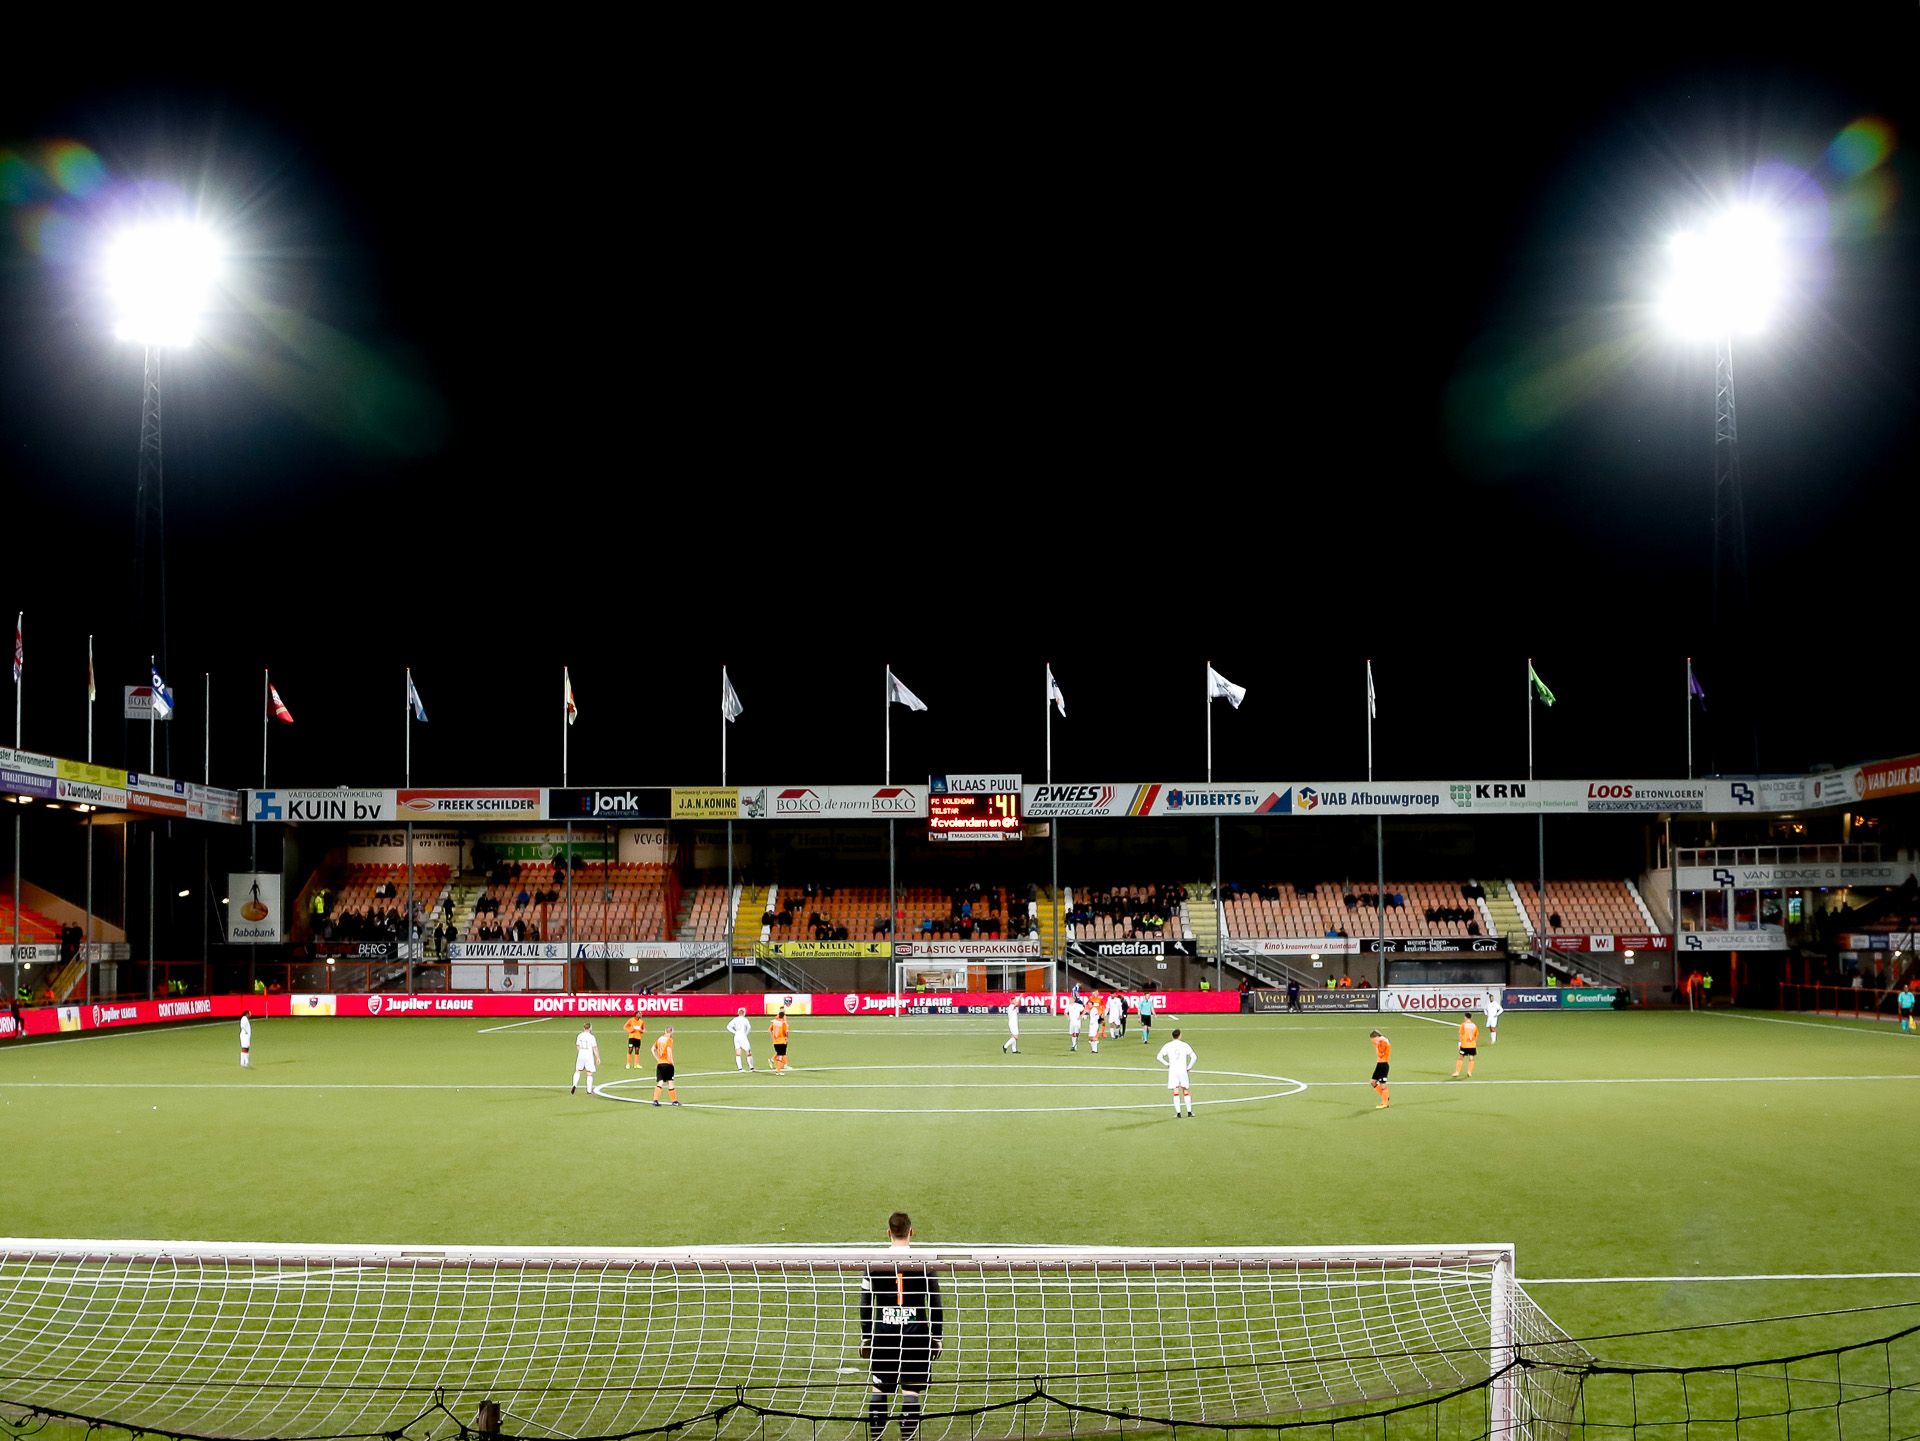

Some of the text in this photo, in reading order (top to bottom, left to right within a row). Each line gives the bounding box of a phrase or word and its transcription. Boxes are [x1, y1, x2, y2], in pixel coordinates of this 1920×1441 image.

[14, 750, 54, 768] Environmentals
[951, 778, 1018, 791] KLAAS PUUL
[1868, 774, 1886, 790] VAN
[1888, 768, 1907, 787] DIJK
[67, 783, 102, 800] Zwarthoed
[1476, 784, 1526, 798] KRN
[1588, 783, 1704, 798] LOOS BETONVLOEREN
[438, 799, 535, 810] FREEK SCHILDER
[593, 791, 639, 816] jonk
[824, 798, 838, 810] de
[839, 801, 870, 809] norm
[871, 798, 916, 810] BOKO
[995, 794, 1016, 817] 41
[1245, 796, 1259, 805] BV
[1321, 792, 1440, 807] VAB Afbouwgroep
[1542, 800, 1579, 808] Nederland
[288, 801, 381, 819] KUIN bv
[989, 819, 1001, 828] en
[1743, 871, 1770, 879] VAN
[1773, 869, 1822, 879] DONGE
[1825, 869, 1836, 878] &
[233, 928, 275, 937] Rabobank
[358, 943, 387, 955] BERG
[466, 943, 541, 957] WWW.MZA.NL
[819, 942, 855, 950] KEULEN
[914, 945, 956, 954] PLASTIC
[958, 945, 1040, 954] VERPAKKINGEN
[1099, 941, 1165, 955] metafa.nl
[1264, 942, 1285, 950] Kino's
[1472, 944, 1497, 952] Carré
[385, 998, 473, 1011] Jupiler LEAGUE
[533, 998, 683, 1011] DON'T DRINK & DRIVE!
[862, 997, 910, 1010] Jupiler
[1397, 994, 1481, 1009] Veldboer
[1517, 994, 1558, 1002] TENCATE
[174, 1001, 190, 1015] DRINK
[895, 1273, 903, 1306] 1
